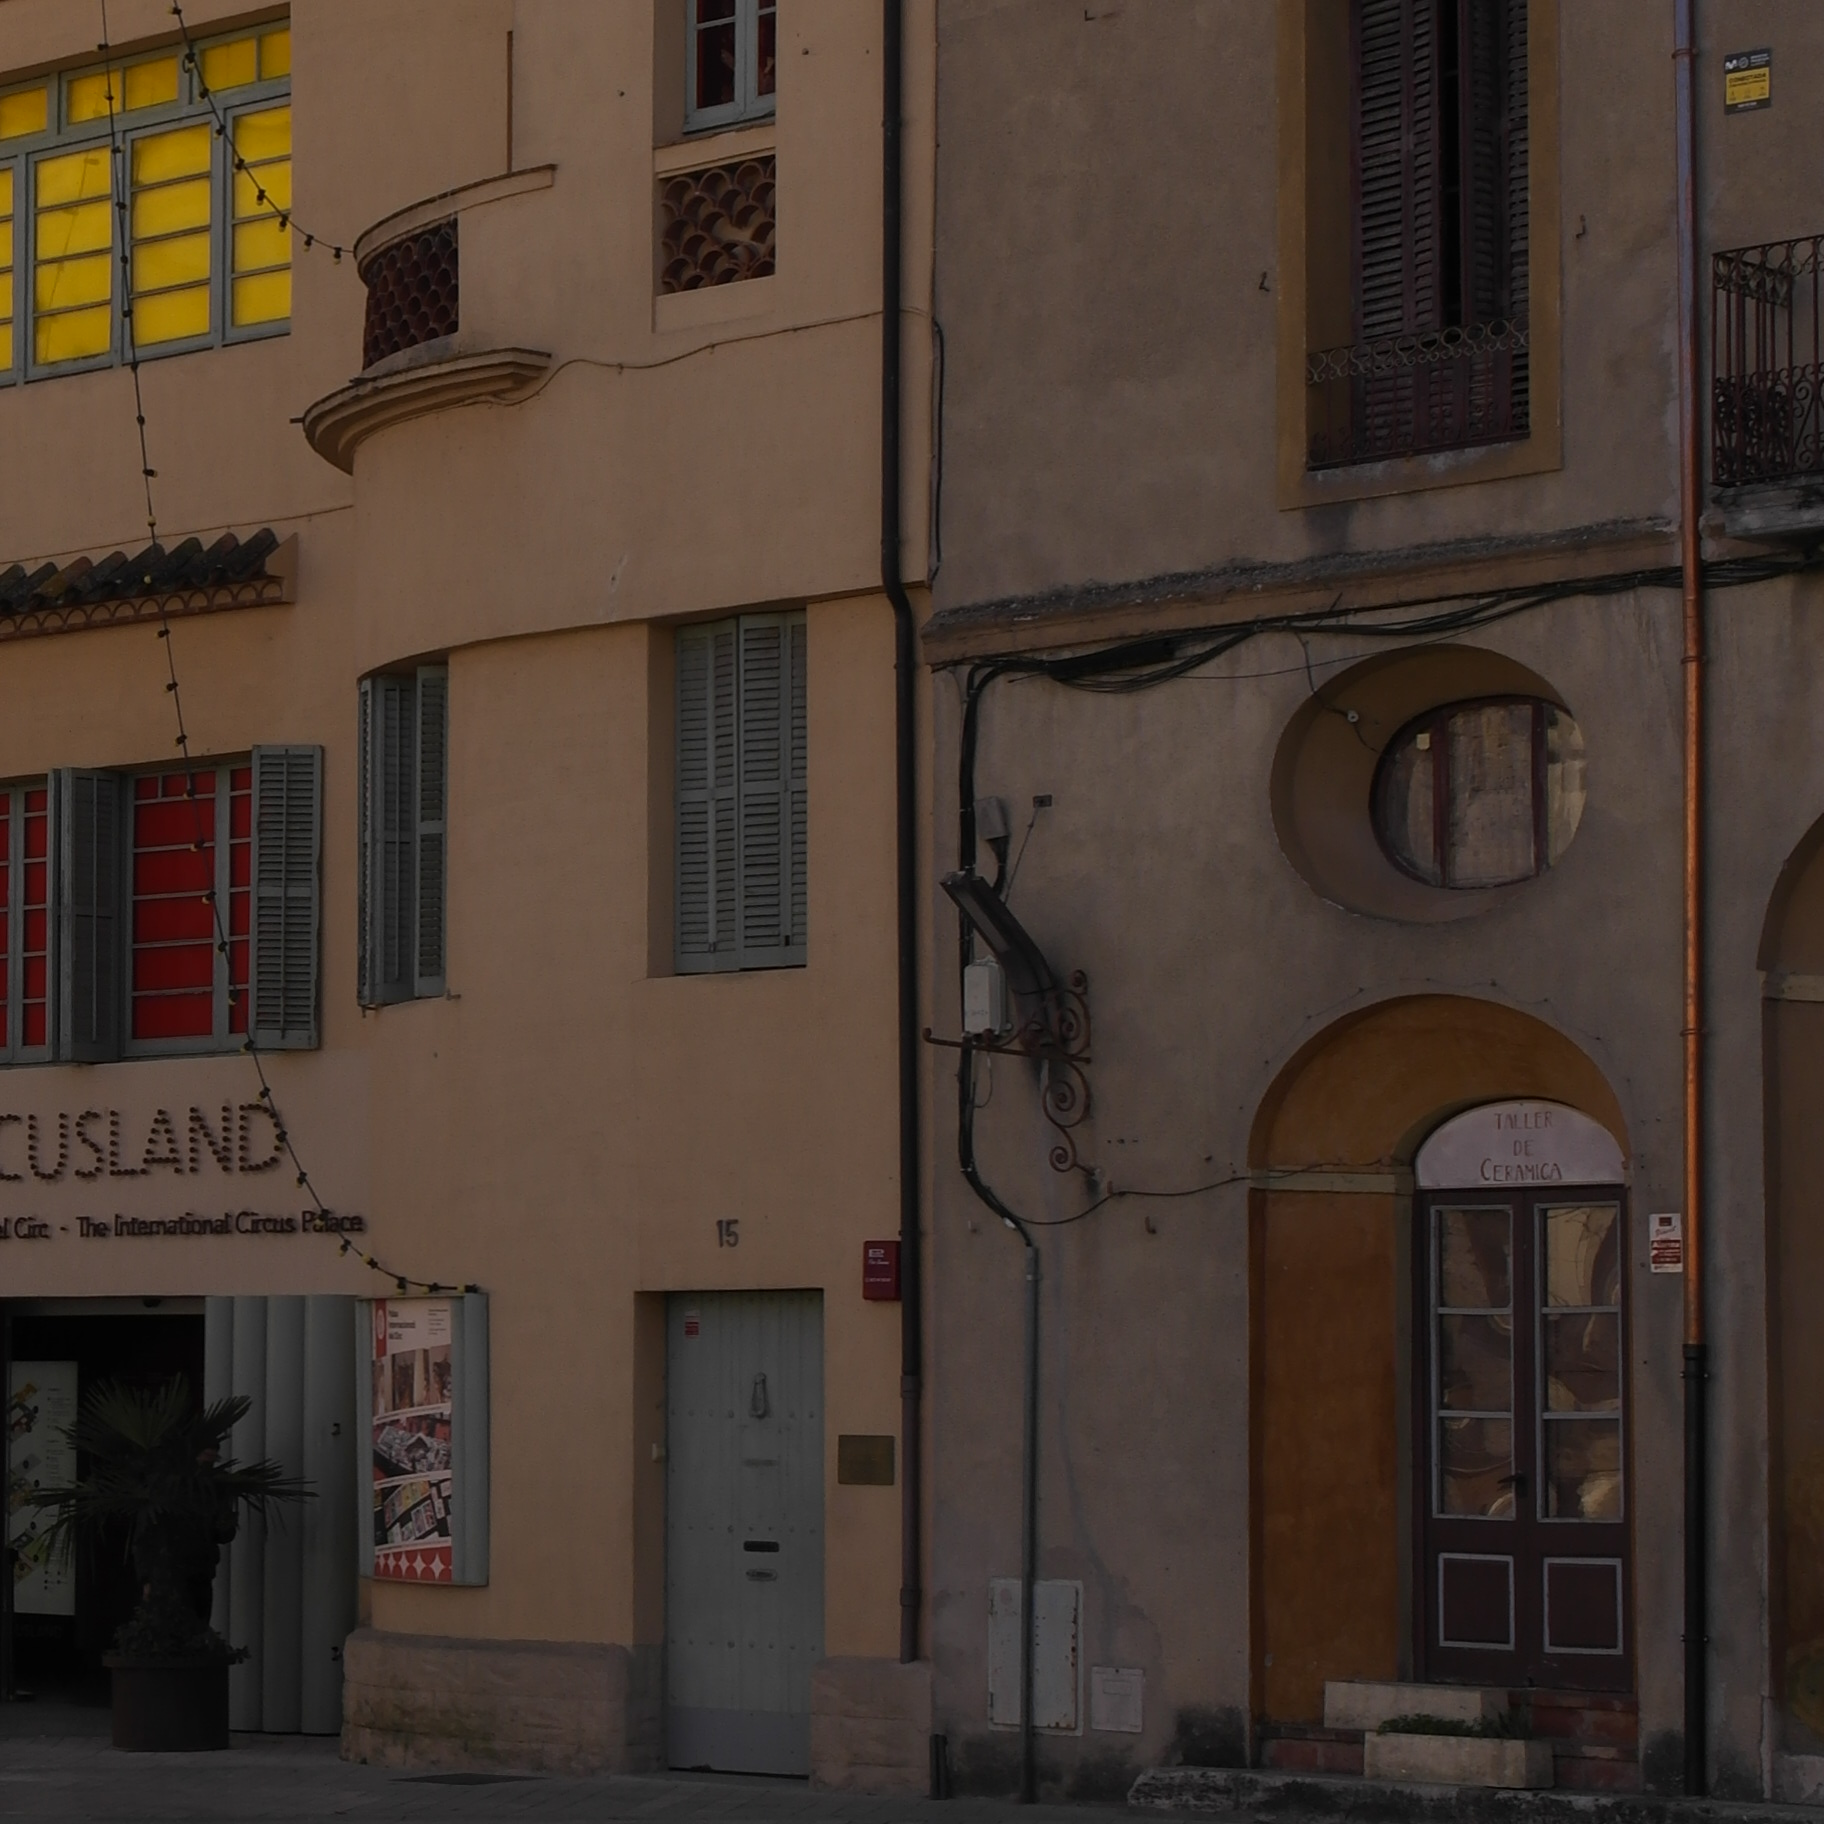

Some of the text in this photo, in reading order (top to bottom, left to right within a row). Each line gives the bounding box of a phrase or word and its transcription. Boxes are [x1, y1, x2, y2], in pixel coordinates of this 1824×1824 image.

[1494, 1111, 1553, 1129] TALLER
[1513, 1139, 1535, 1157] DE
[14, 1216, 50, 1239] Circ
[76, 1216, 109, 1238] The
[114, 1212, 232, 1236] International
[234, 1210, 297, 1235] Circus
[302, 1209, 366, 1234] Palace
[716, 1219, 739, 1248] 15
